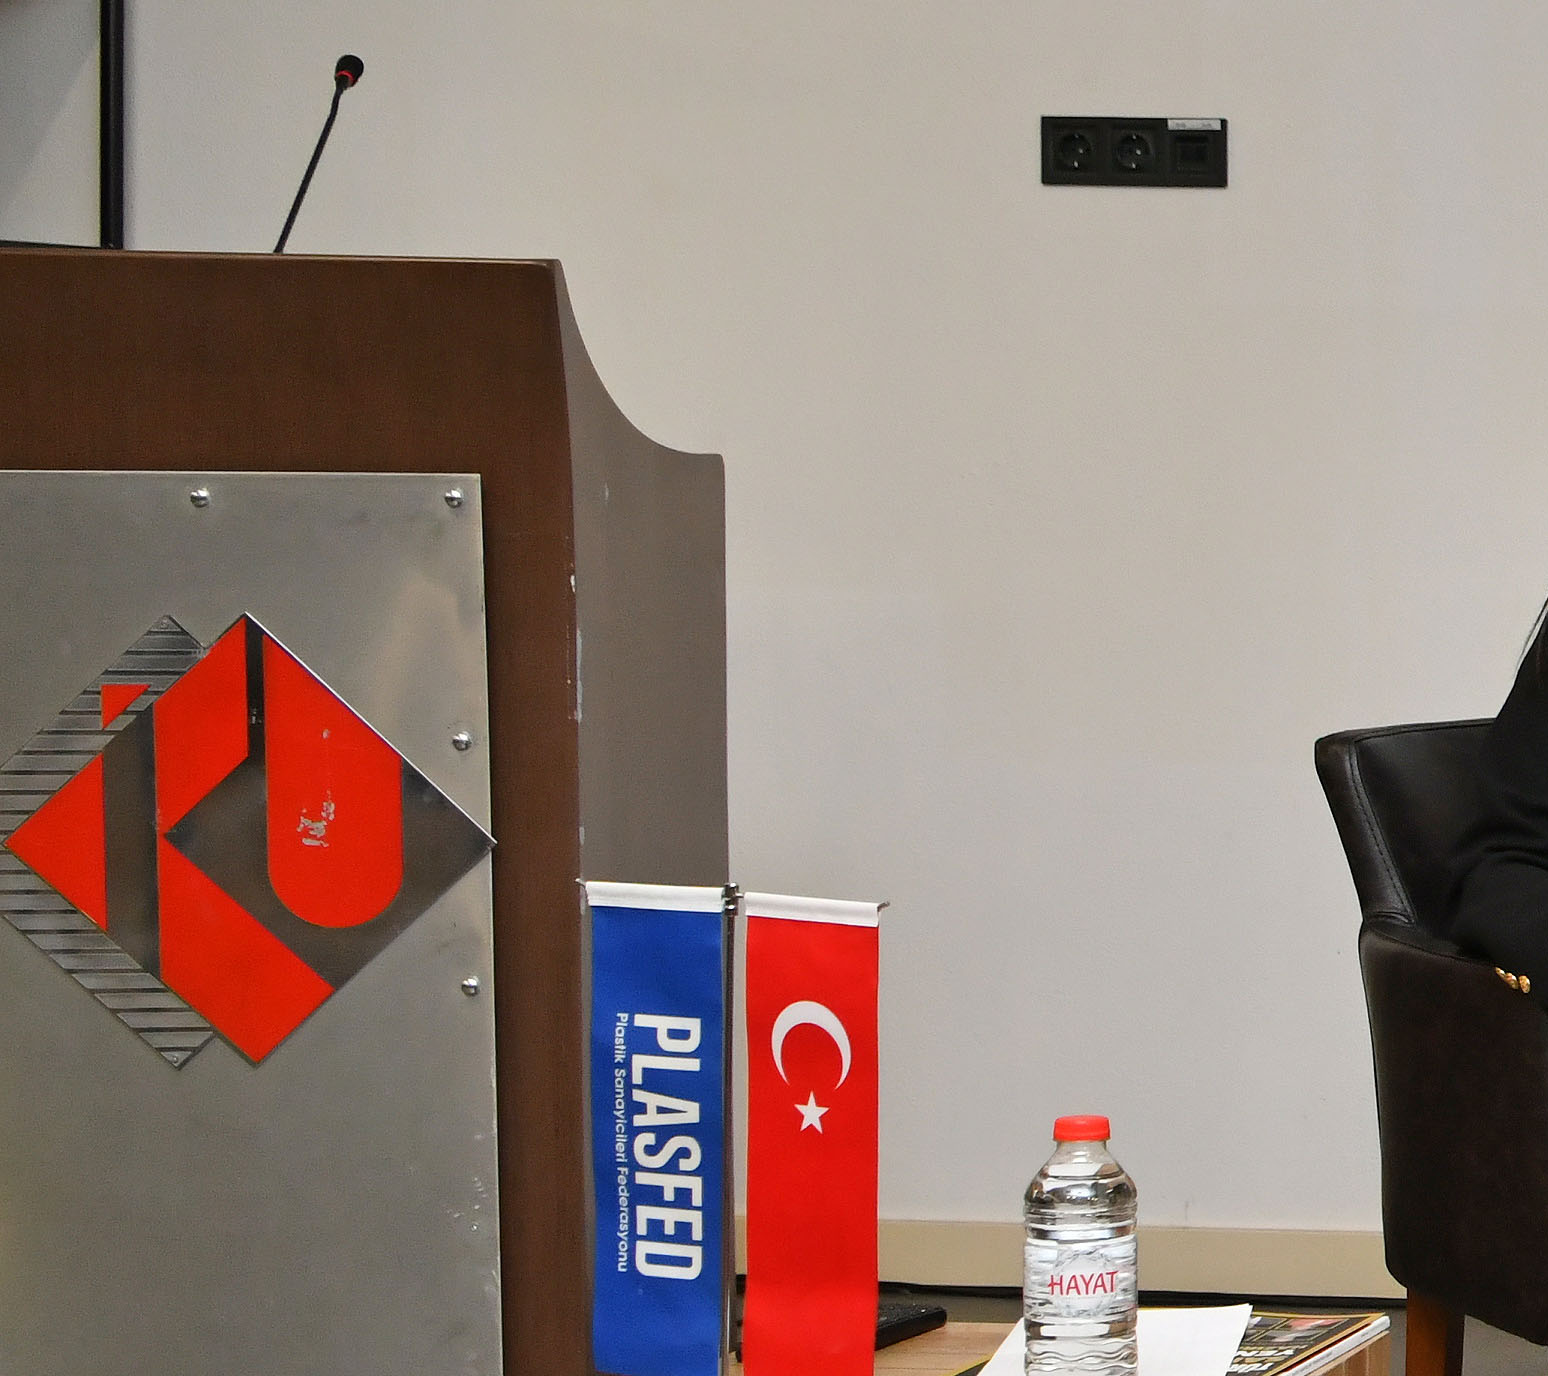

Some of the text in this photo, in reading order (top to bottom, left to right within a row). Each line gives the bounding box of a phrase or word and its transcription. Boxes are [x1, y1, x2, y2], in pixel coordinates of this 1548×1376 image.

[613, 1012, 630, 1272] Plastik Sanayicileri Federasyonu
[631, 1014, 704, 1281] PLASFED
[1048, 1270, 1119, 1295] HAYAT
